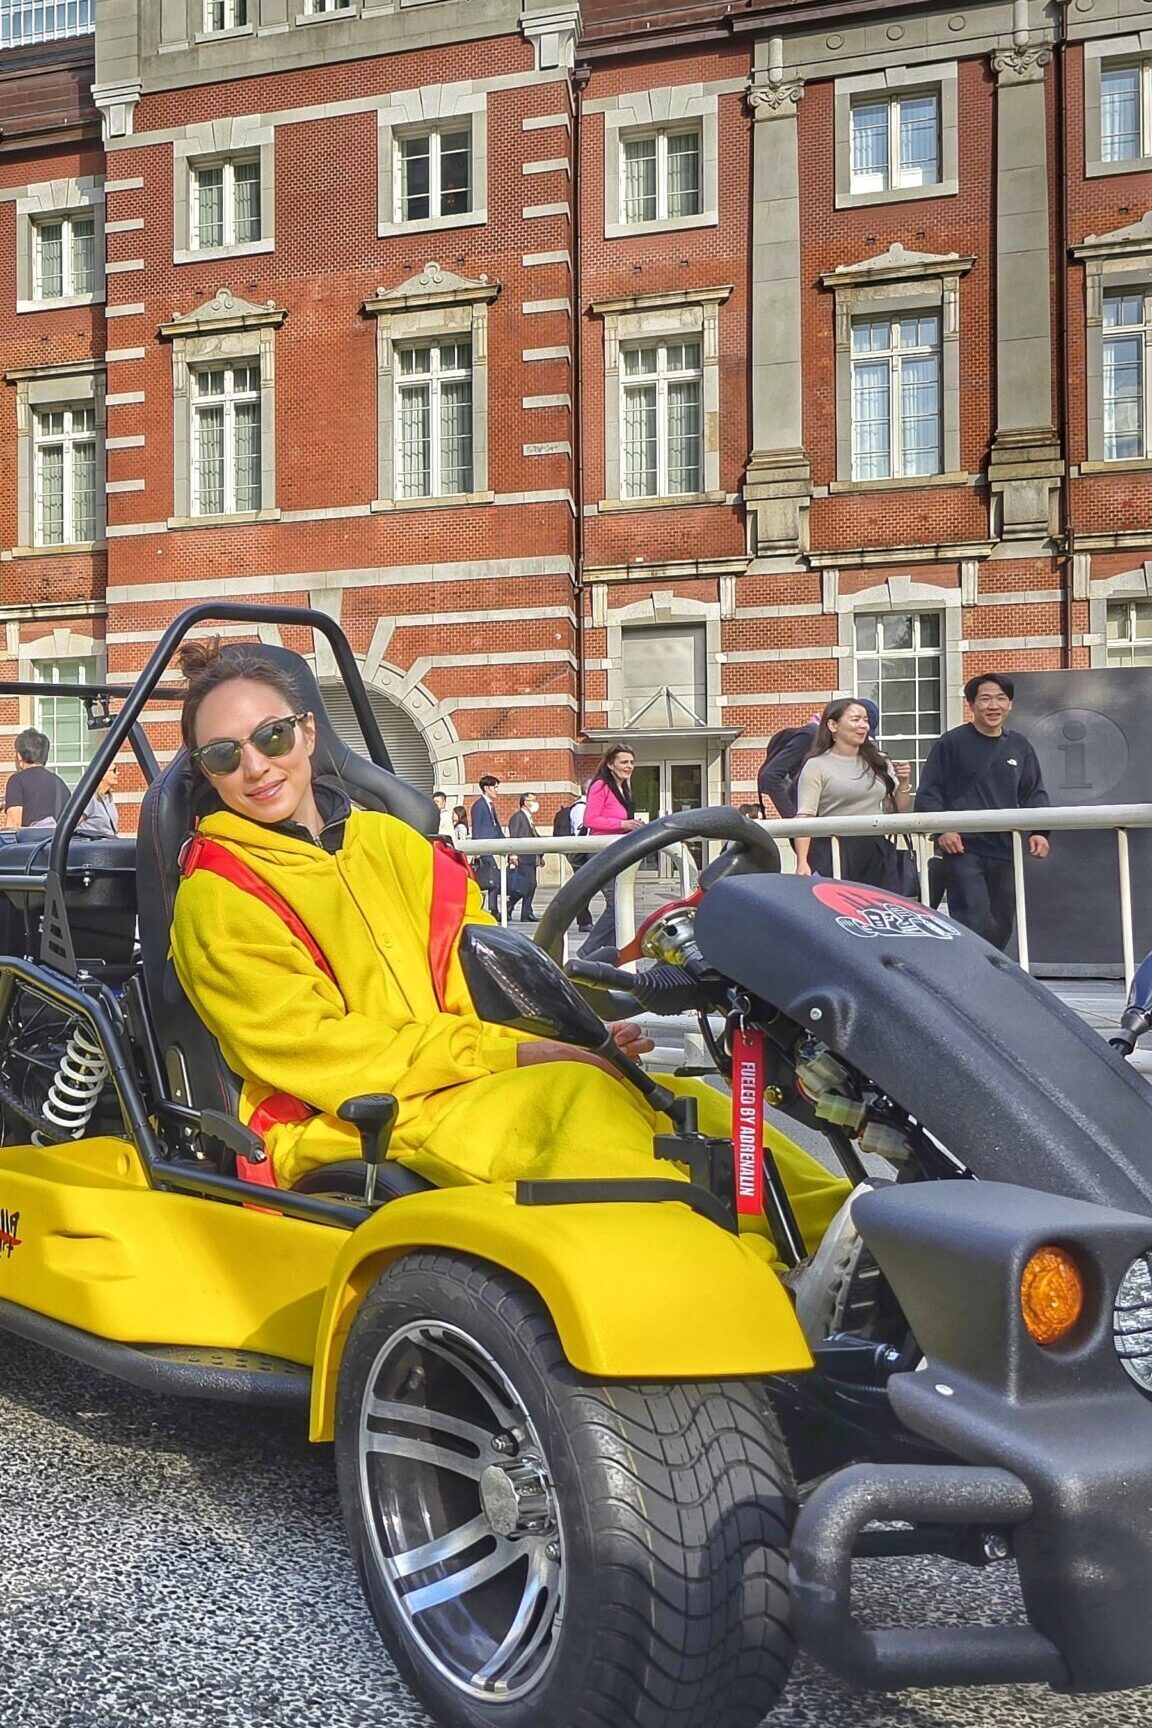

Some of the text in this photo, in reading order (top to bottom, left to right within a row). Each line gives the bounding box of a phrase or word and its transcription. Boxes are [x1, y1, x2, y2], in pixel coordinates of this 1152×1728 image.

[739, 1061, 756, 1197] FUELED BY ADRENALIN
